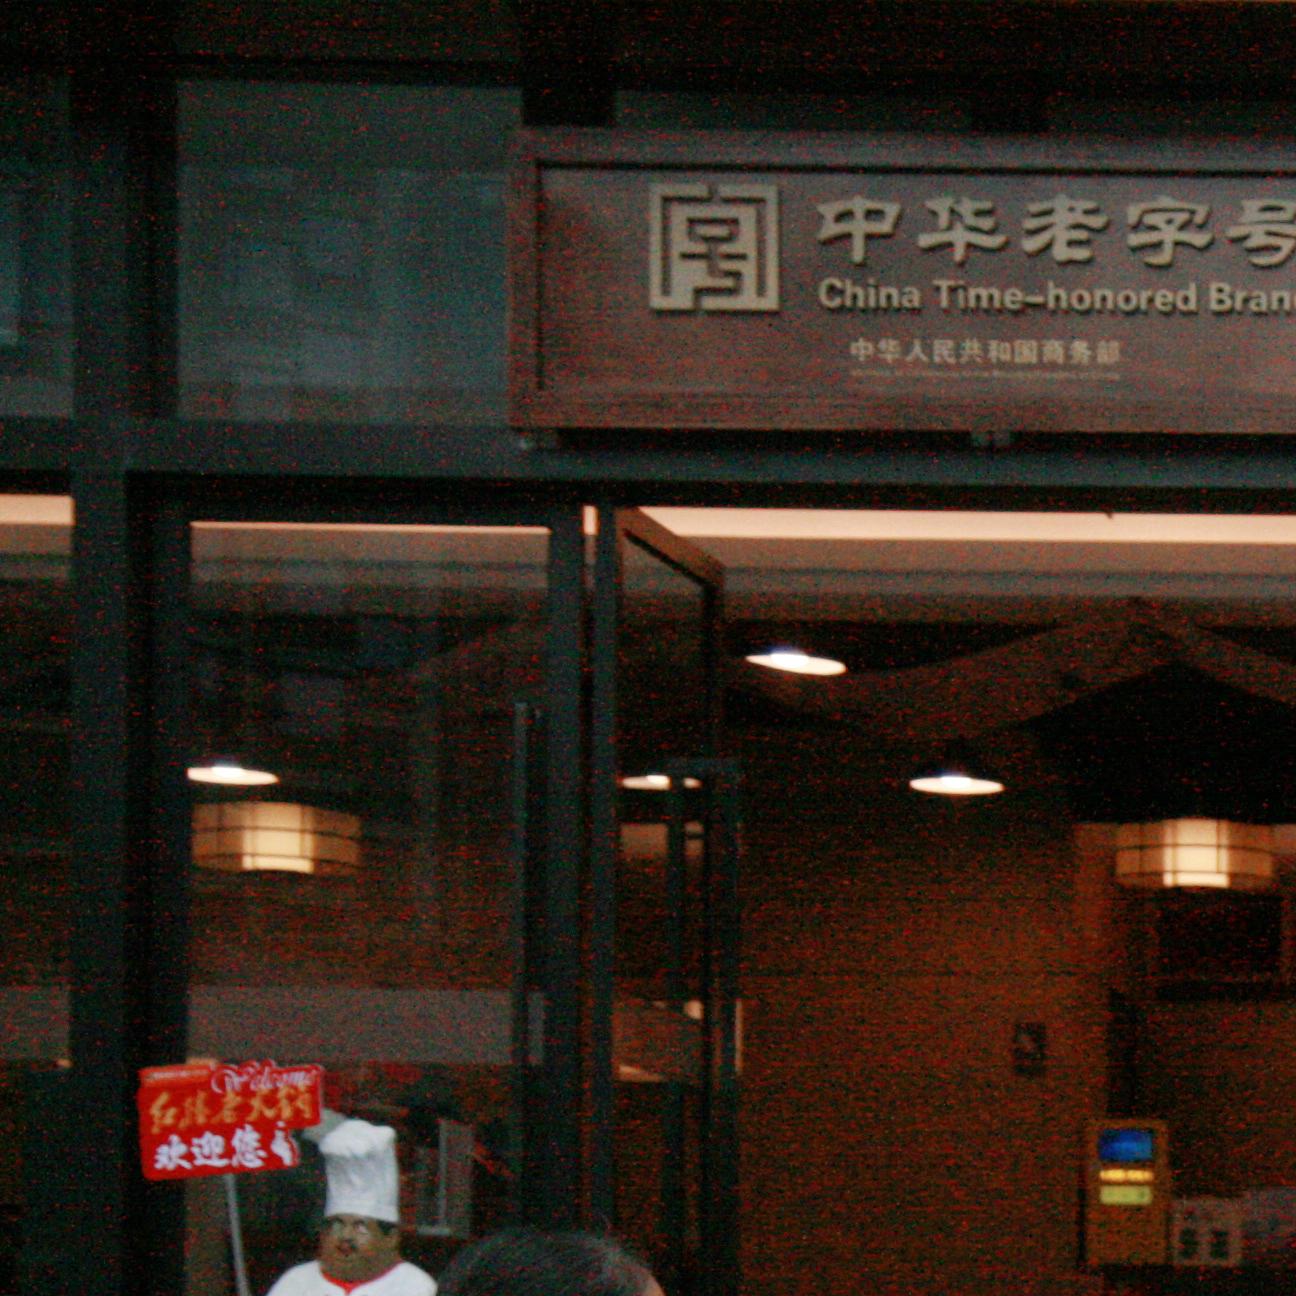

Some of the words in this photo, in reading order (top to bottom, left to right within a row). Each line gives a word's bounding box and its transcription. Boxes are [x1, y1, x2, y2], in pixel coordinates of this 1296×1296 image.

[818, 277, 922, 313] China
[932, 278, 1198, 315] Time-honored
[850, 338, 1121, 365] 中华人民共和国商务部
[153, 1123, 267, 1171] 欢迎您
